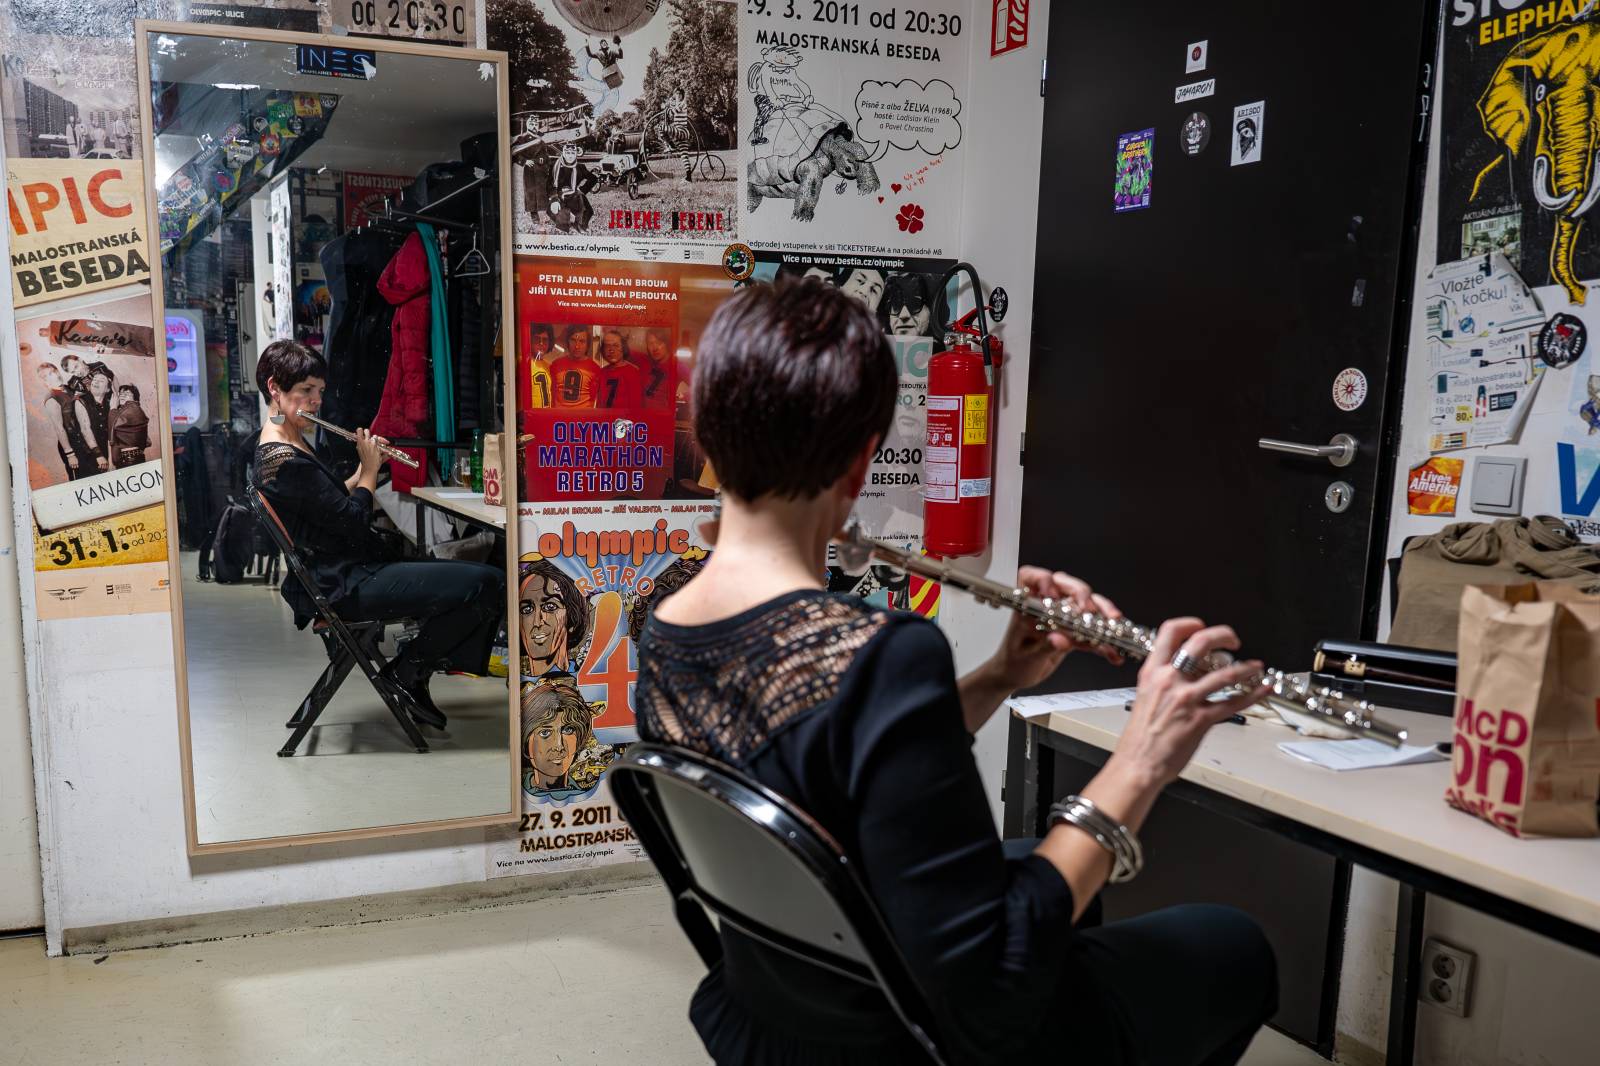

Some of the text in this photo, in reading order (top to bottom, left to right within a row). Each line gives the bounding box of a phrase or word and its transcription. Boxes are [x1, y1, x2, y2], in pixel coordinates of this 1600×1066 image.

[225, 10, 245, 19] ULICE
[813, 0, 859, 26] 2011
[869, 8, 895, 30] od
[904, 10, 962, 37] 20:30
[756, 30, 941, 62] MALOSTRANSKÁ BESEDA
[903, 99, 930, 113] ŽELVA
[12, 227, 142, 267] MALOSTRANSKÁ
[524, 243, 620, 253] www.bestia.cz/olympic
[837, 244, 886, 254] TICKETSTREAM
[801, 256, 812, 264] na
[813, 256, 905, 268] www.bestia.cz/olympic
[16, 249, 150, 297] BESEDA
[538, 274, 669, 288] PETR JANDA MILAN BROUM
[1440, 274, 1485, 295] Vložte
[550, 287, 593, 297] VALENTA
[595, 289, 627, 299] MILAN
[629, 291, 678, 301] PEROUTKA
[1462, 285, 1508, 306] kočku!
[918, 394, 926, 406] 2
[538, 445, 663, 468] MARATHON
[873, 448, 923, 464] 20:30
[556, 470, 645, 492] RETRO 5
[871, 472, 920, 485] BESEDA
[1409, 477, 1459, 495] Amerika
[859, 490, 886, 498] olympic
[542, 506, 570, 516] MILAN
[572, 506, 603, 515] BROUM
[628, 505, 663, 514] VALENTA
[670, 505, 697, 514] MILAN
[117, 522, 146, 537] 2012
[50, 529, 130, 566] 31. 1.
[131, 537, 145, 547] od
[538, 518, 690, 568] olympic
[574, 565, 655, 597] RETRO
[577, 591, 638, 729] 4
[550, 810, 566, 828] 9.
[572, 805, 612, 826] 2011
[514, 858, 525, 866] na
[526, 848, 615, 864] www.bestia.cz/olympic
